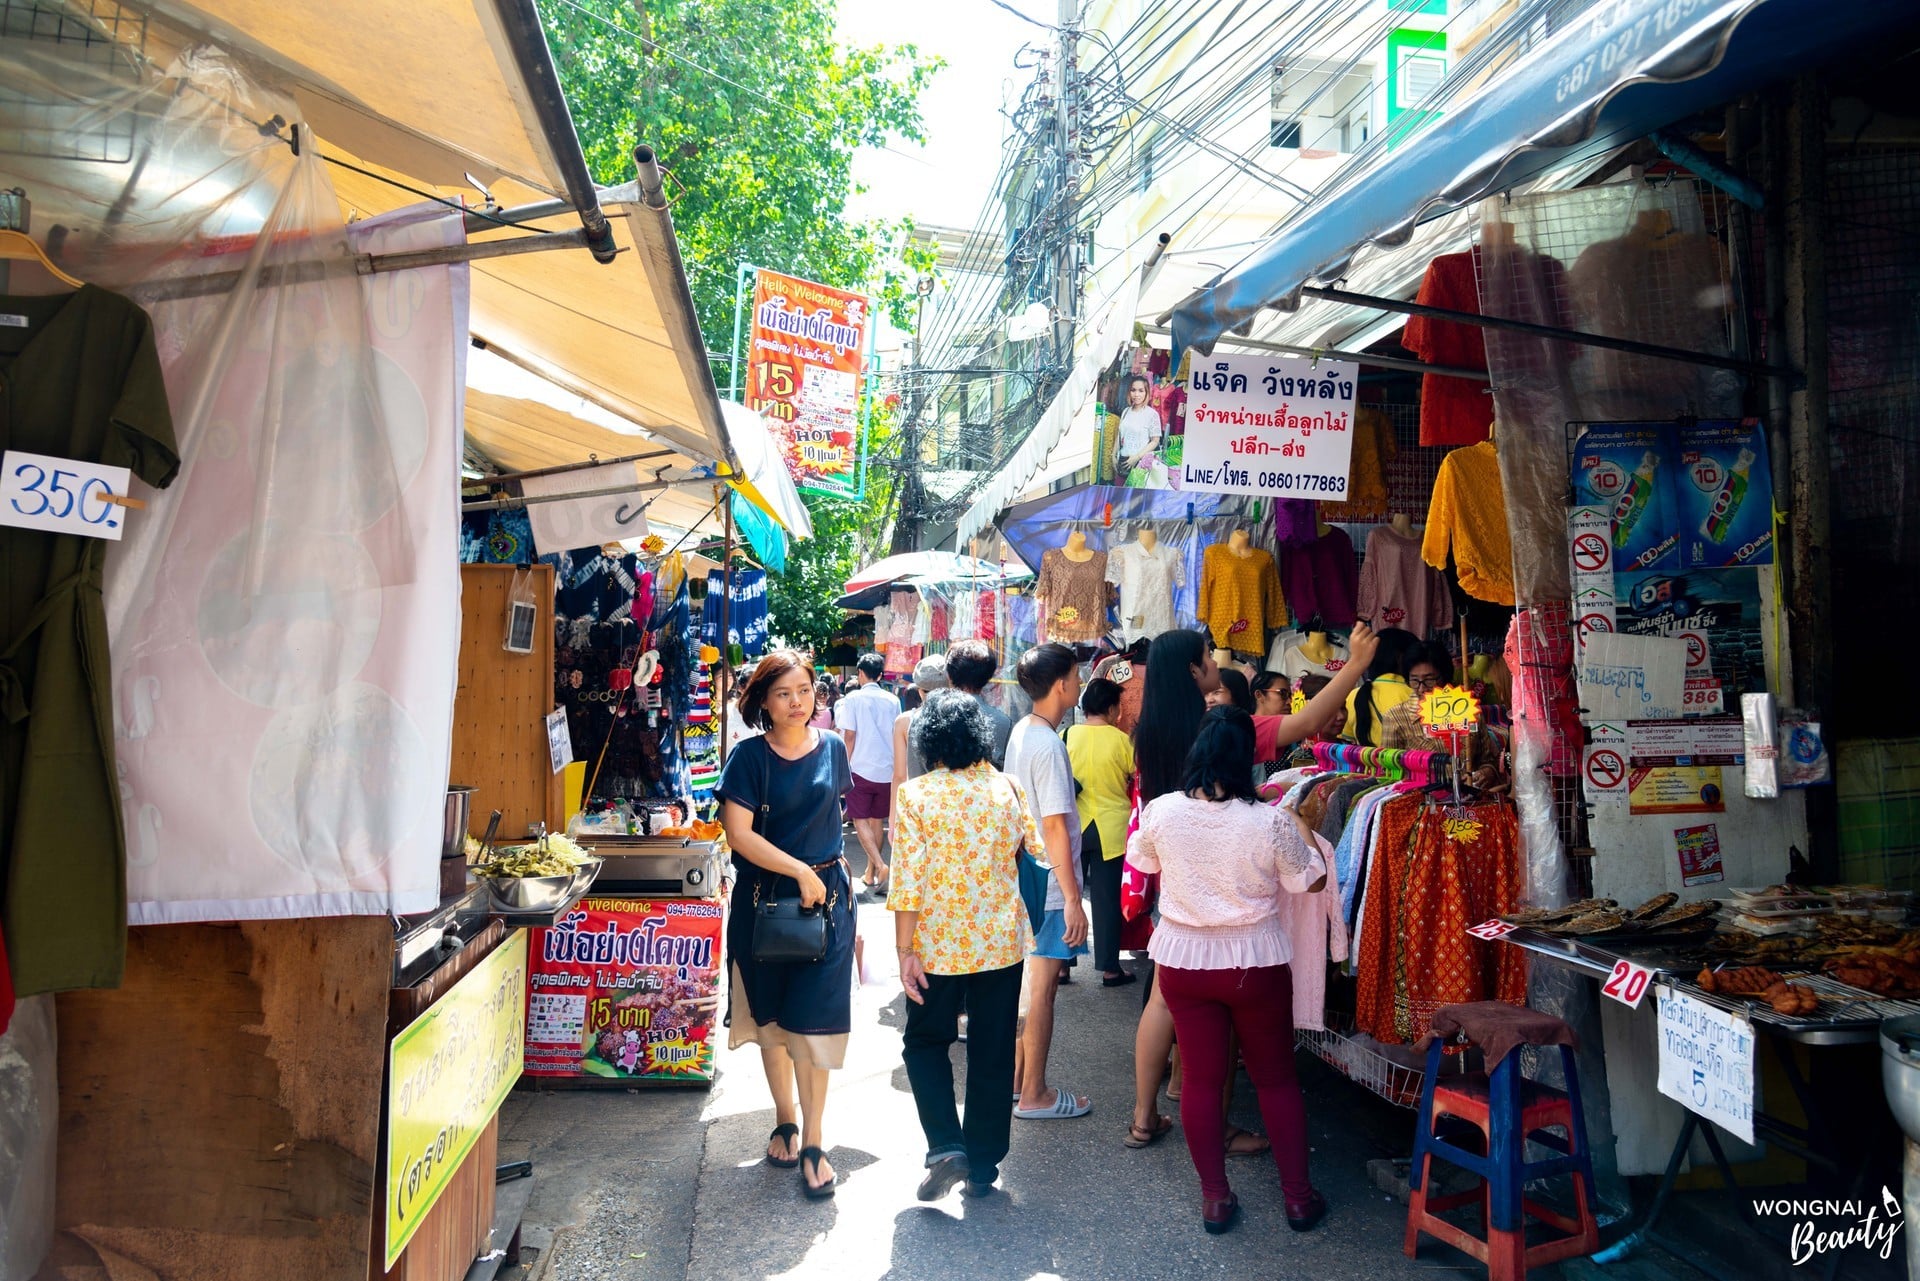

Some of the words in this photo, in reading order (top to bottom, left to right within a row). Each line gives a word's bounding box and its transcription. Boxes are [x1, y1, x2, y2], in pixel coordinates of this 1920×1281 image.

[759, 275, 789, 295] Hello
[793, 284, 844, 309] Welcome
[760, 297, 858, 354] เนื้อย่างโคขุน
[755, 361, 795, 397] 15
[1193, 362, 1248, 393] แจ็ค
[1262, 367, 1353, 400] วังหลัง
[1194, 403, 1348, 436] จำหน่ายเสื้อลูกไม้
[795, 430, 833, 442] HOT
[1231, 435, 1305, 457] ปลีก-ส่ง
[804, 446, 815, 459] 10
[804, 480, 844, 492] 094-7762641
[1259, 471, 1345, 492] 0860177863
[11, 463, 118, 528] 350.
[1061, 610, 1076, 620] 150
[1230, 620, 1247, 633] 150
[1111, 667, 1130, 682] 150
[1430, 696, 1469, 722] 150
[1450, 819, 1473, 835] 250
[588, 898, 651, 914] Welcome
[667, 904, 722, 918] 094-7762641
[1471, 919, 1513, 938] 25
[545, 912, 713, 981] เนื้อย่างโคขุน
[531, 972, 591, 990] สูตรพิเศษ
[596, 969, 663, 990] ไม่ง้อน้ำจิ้ม
[1603, 961, 1648, 1001] 20
[590, 998, 612, 1032] 15
[618, 1007, 651, 1029] บาท
[647, 1025, 689, 1044] HOT
[655, 1048, 668, 1062] 10
[670, 1047, 692, 1063] แถม
[1692, 1069, 1707, 1107] 5
